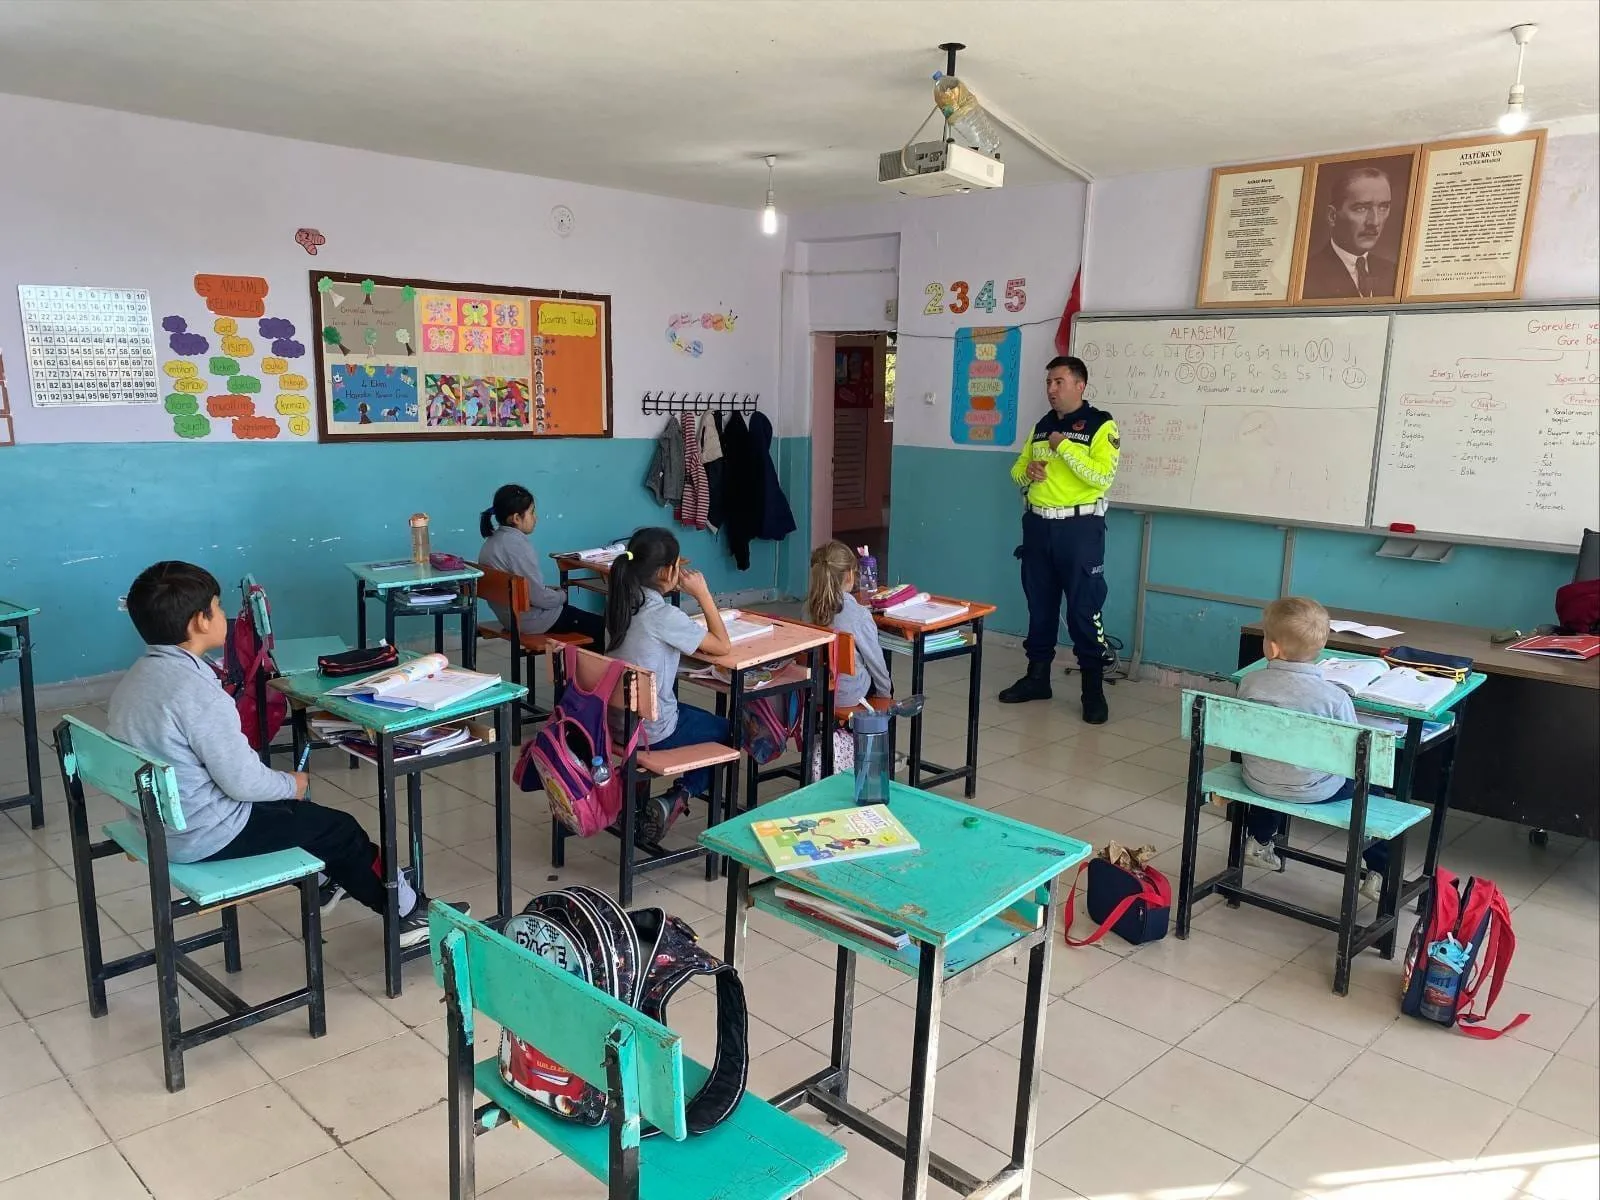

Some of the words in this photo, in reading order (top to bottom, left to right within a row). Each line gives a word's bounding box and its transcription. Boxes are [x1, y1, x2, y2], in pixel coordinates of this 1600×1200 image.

[924, 282, 944, 315] 2
[949, 281, 969, 314] 3
[974, 280, 996, 313] 4
[1004, 278, 1026, 312] 5
[30, 335, 40, 343] 41
[81, 336, 90, 344] 45
[32, 347, 41, 355] 51
[44, 347, 54, 355] 52
[57, 347, 67, 355] 53
[70, 347, 79, 355] 54
[82, 347, 92, 355] 55
[94, 347, 104, 355] 56
[106, 347, 116, 355] 57
[34, 370, 44, 378] 71
[47, 370, 57, 378] 72
[144, 369, 154, 377] 80
[36, 381, 45, 389] 81
[49, 381, 58, 389] 82
[61, 381, 71, 389] 83
[74, 381, 83, 389] 84
[86, 381, 96, 389] 85
[134, 380, 143, 388] 89
[145, 380, 155, 388] 90
[37, 393, 47, 401] 91
[63, 392, 72, 400] 93
[75, 392, 85, 400] 94
[87, 392, 97, 400] 95
[123, 391, 133, 399] 98
[135, 391, 144, 399] 99
[145, 391, 157, 399] 100
